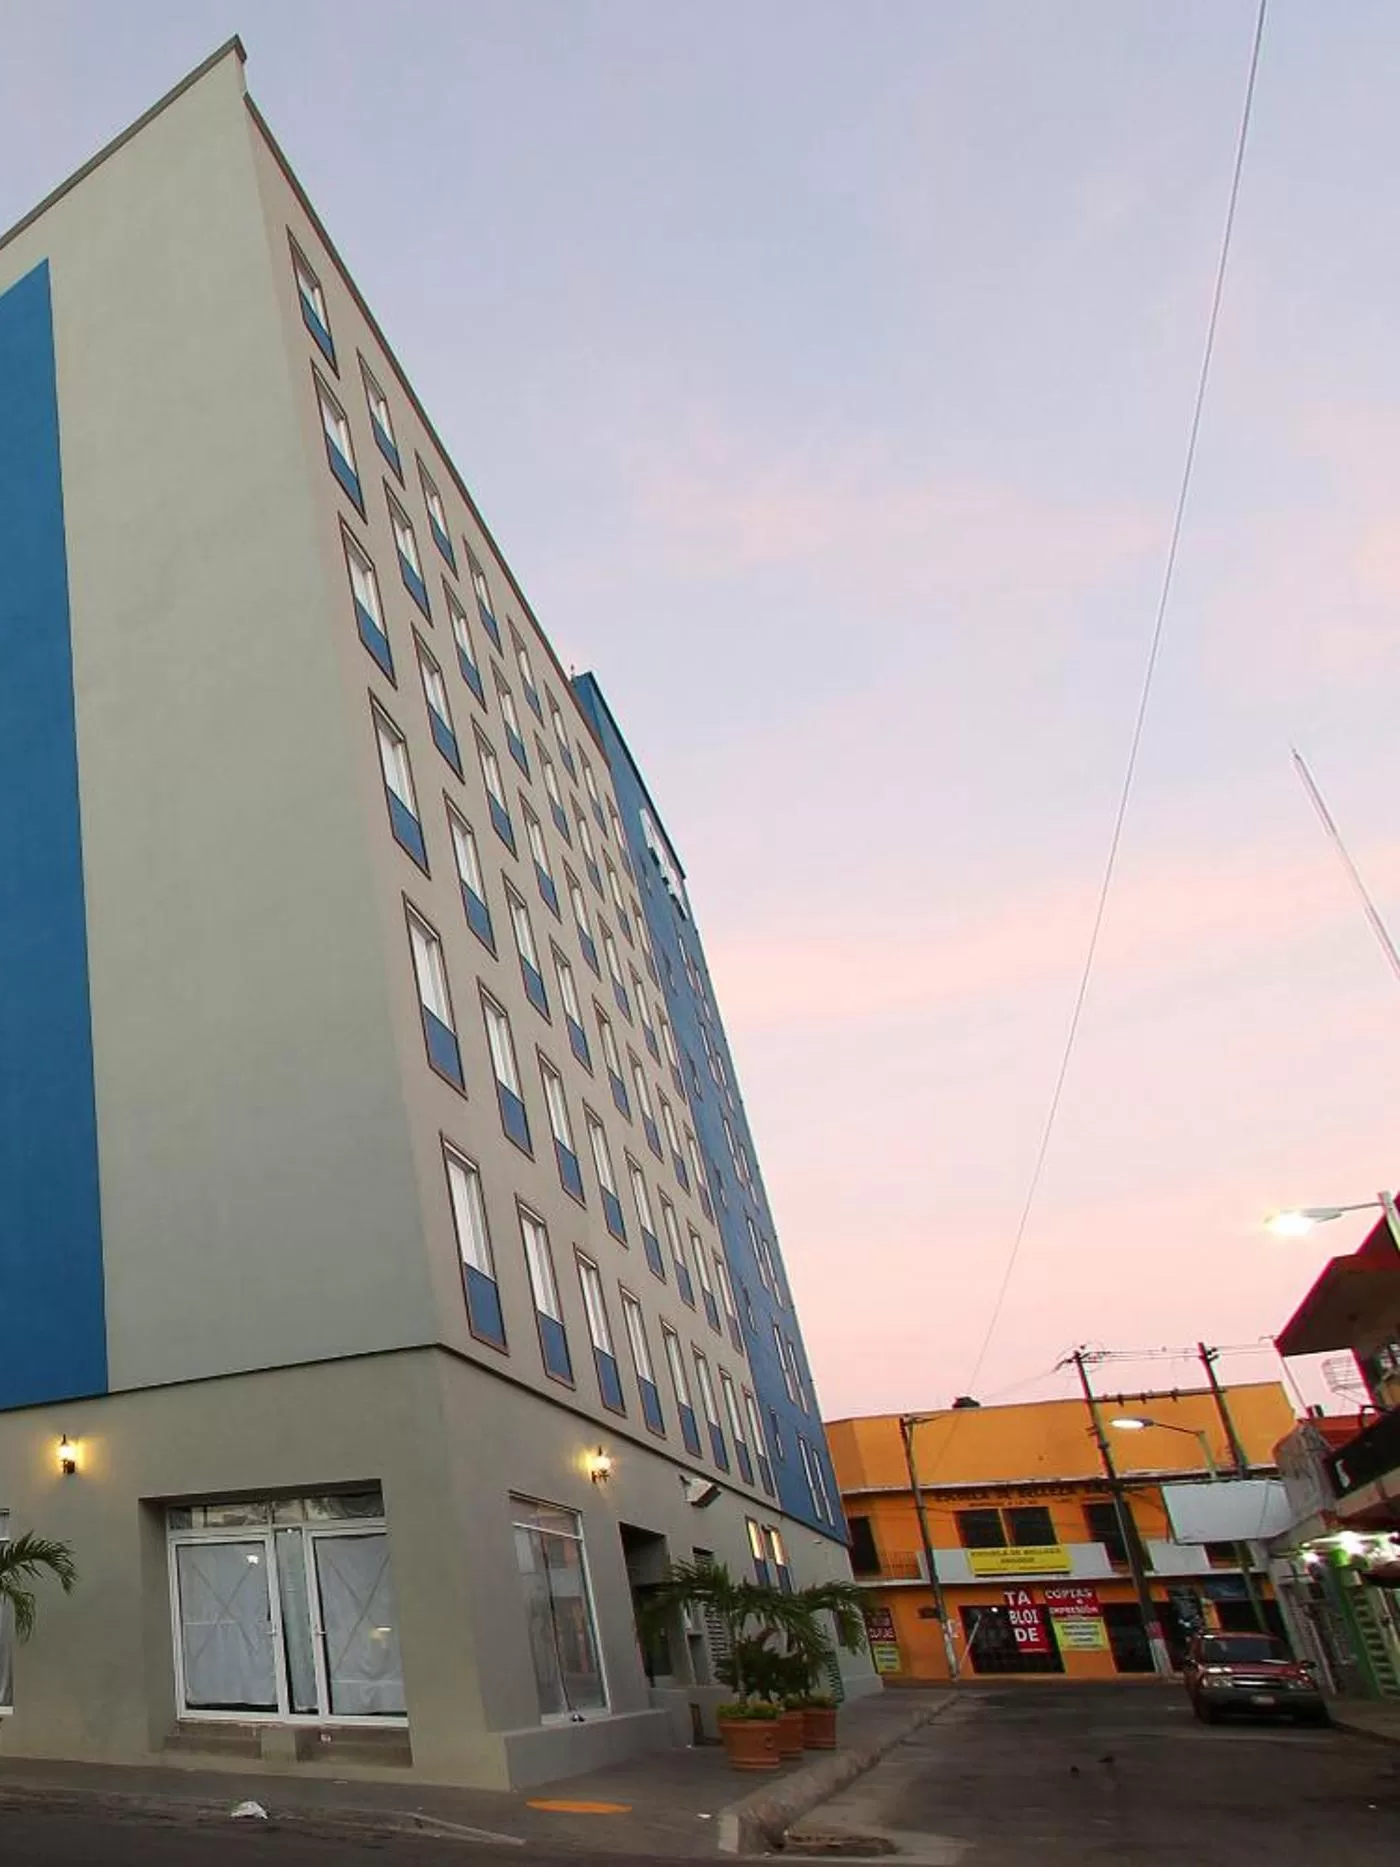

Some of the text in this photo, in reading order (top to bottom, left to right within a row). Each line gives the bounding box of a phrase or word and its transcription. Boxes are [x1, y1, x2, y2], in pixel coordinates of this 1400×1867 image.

[1003, 1590, 1031, 1606] TA
[1009, 1609, 1039, 1625] BLOI
[1014, 1627, 1041, 1642] DE
